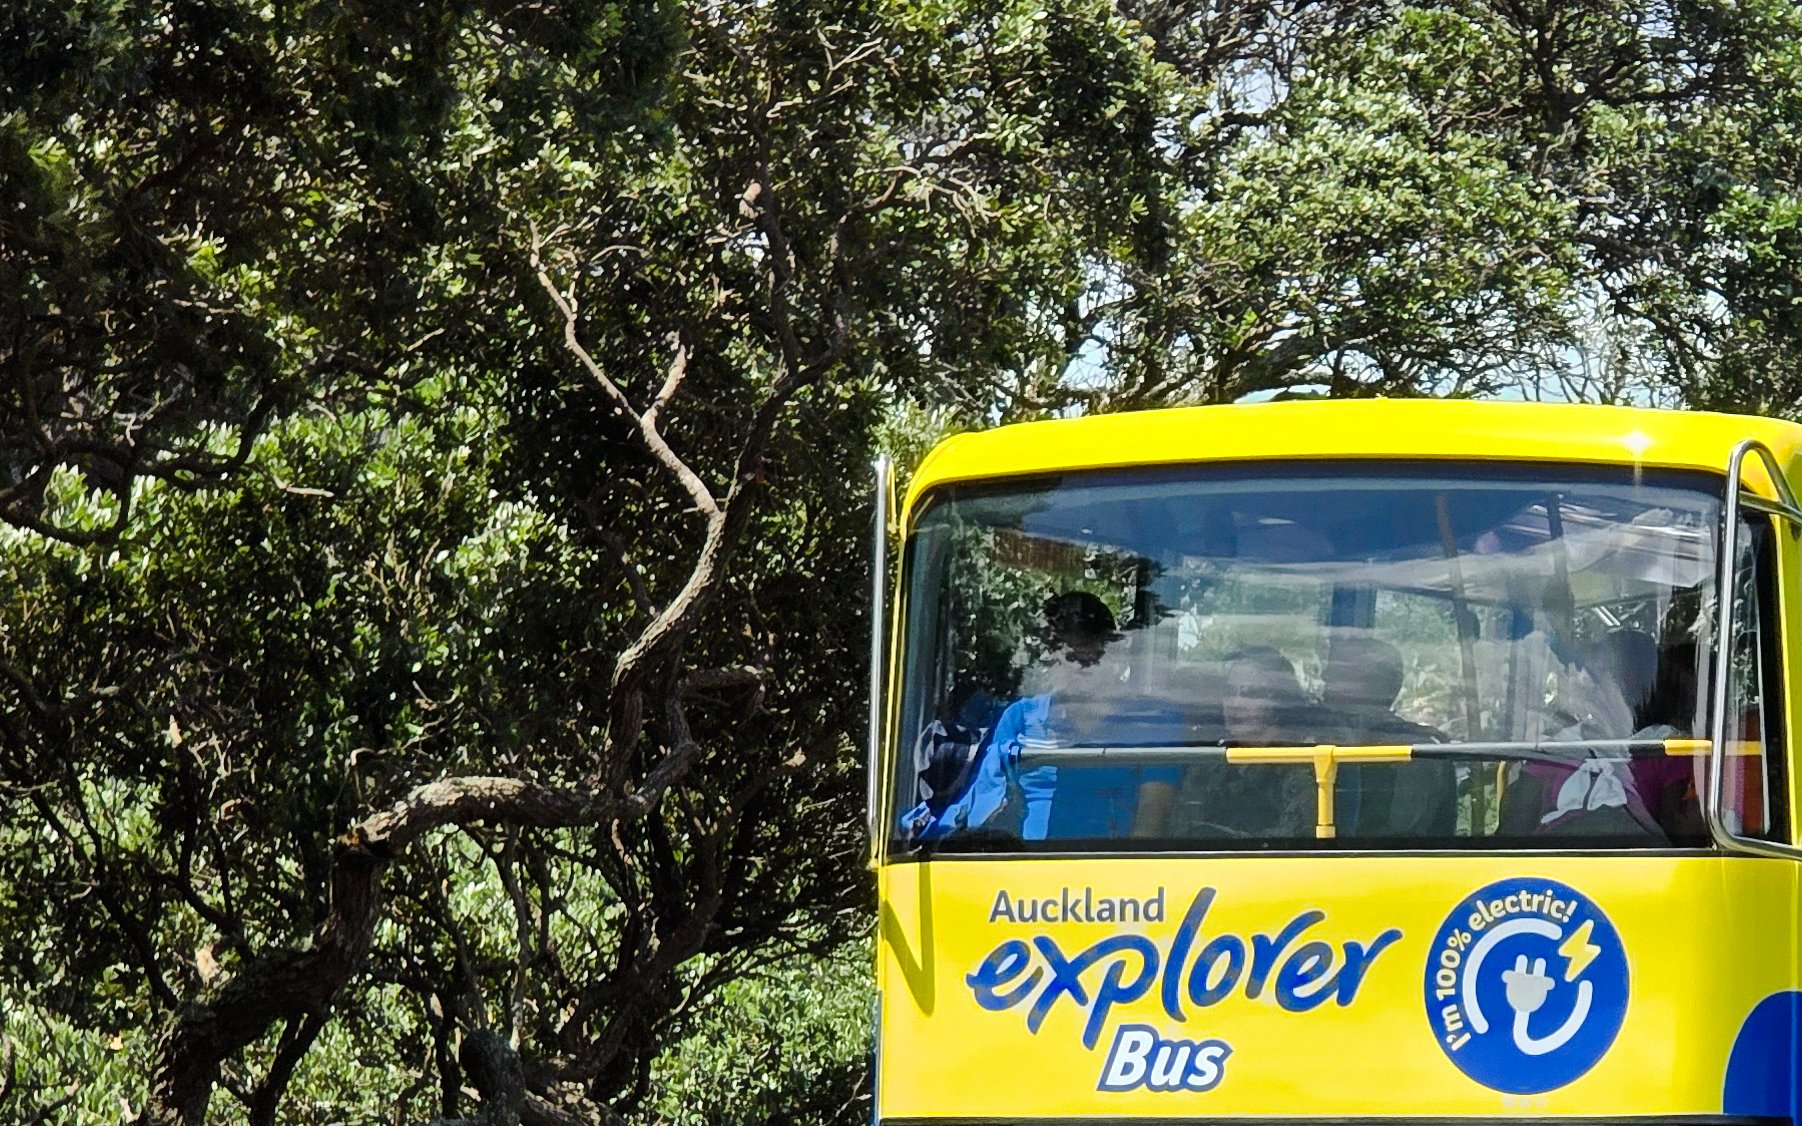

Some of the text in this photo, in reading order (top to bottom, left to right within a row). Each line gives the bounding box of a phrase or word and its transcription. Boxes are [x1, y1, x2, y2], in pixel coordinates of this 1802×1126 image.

[989, 887, 1166, 924] Auckland
[966, 886, 1404, 1051] explorer
[1436, 889, 1578, 1051] I'm 100% electric!
[1098, 1025, 1232, 1092] Bus
